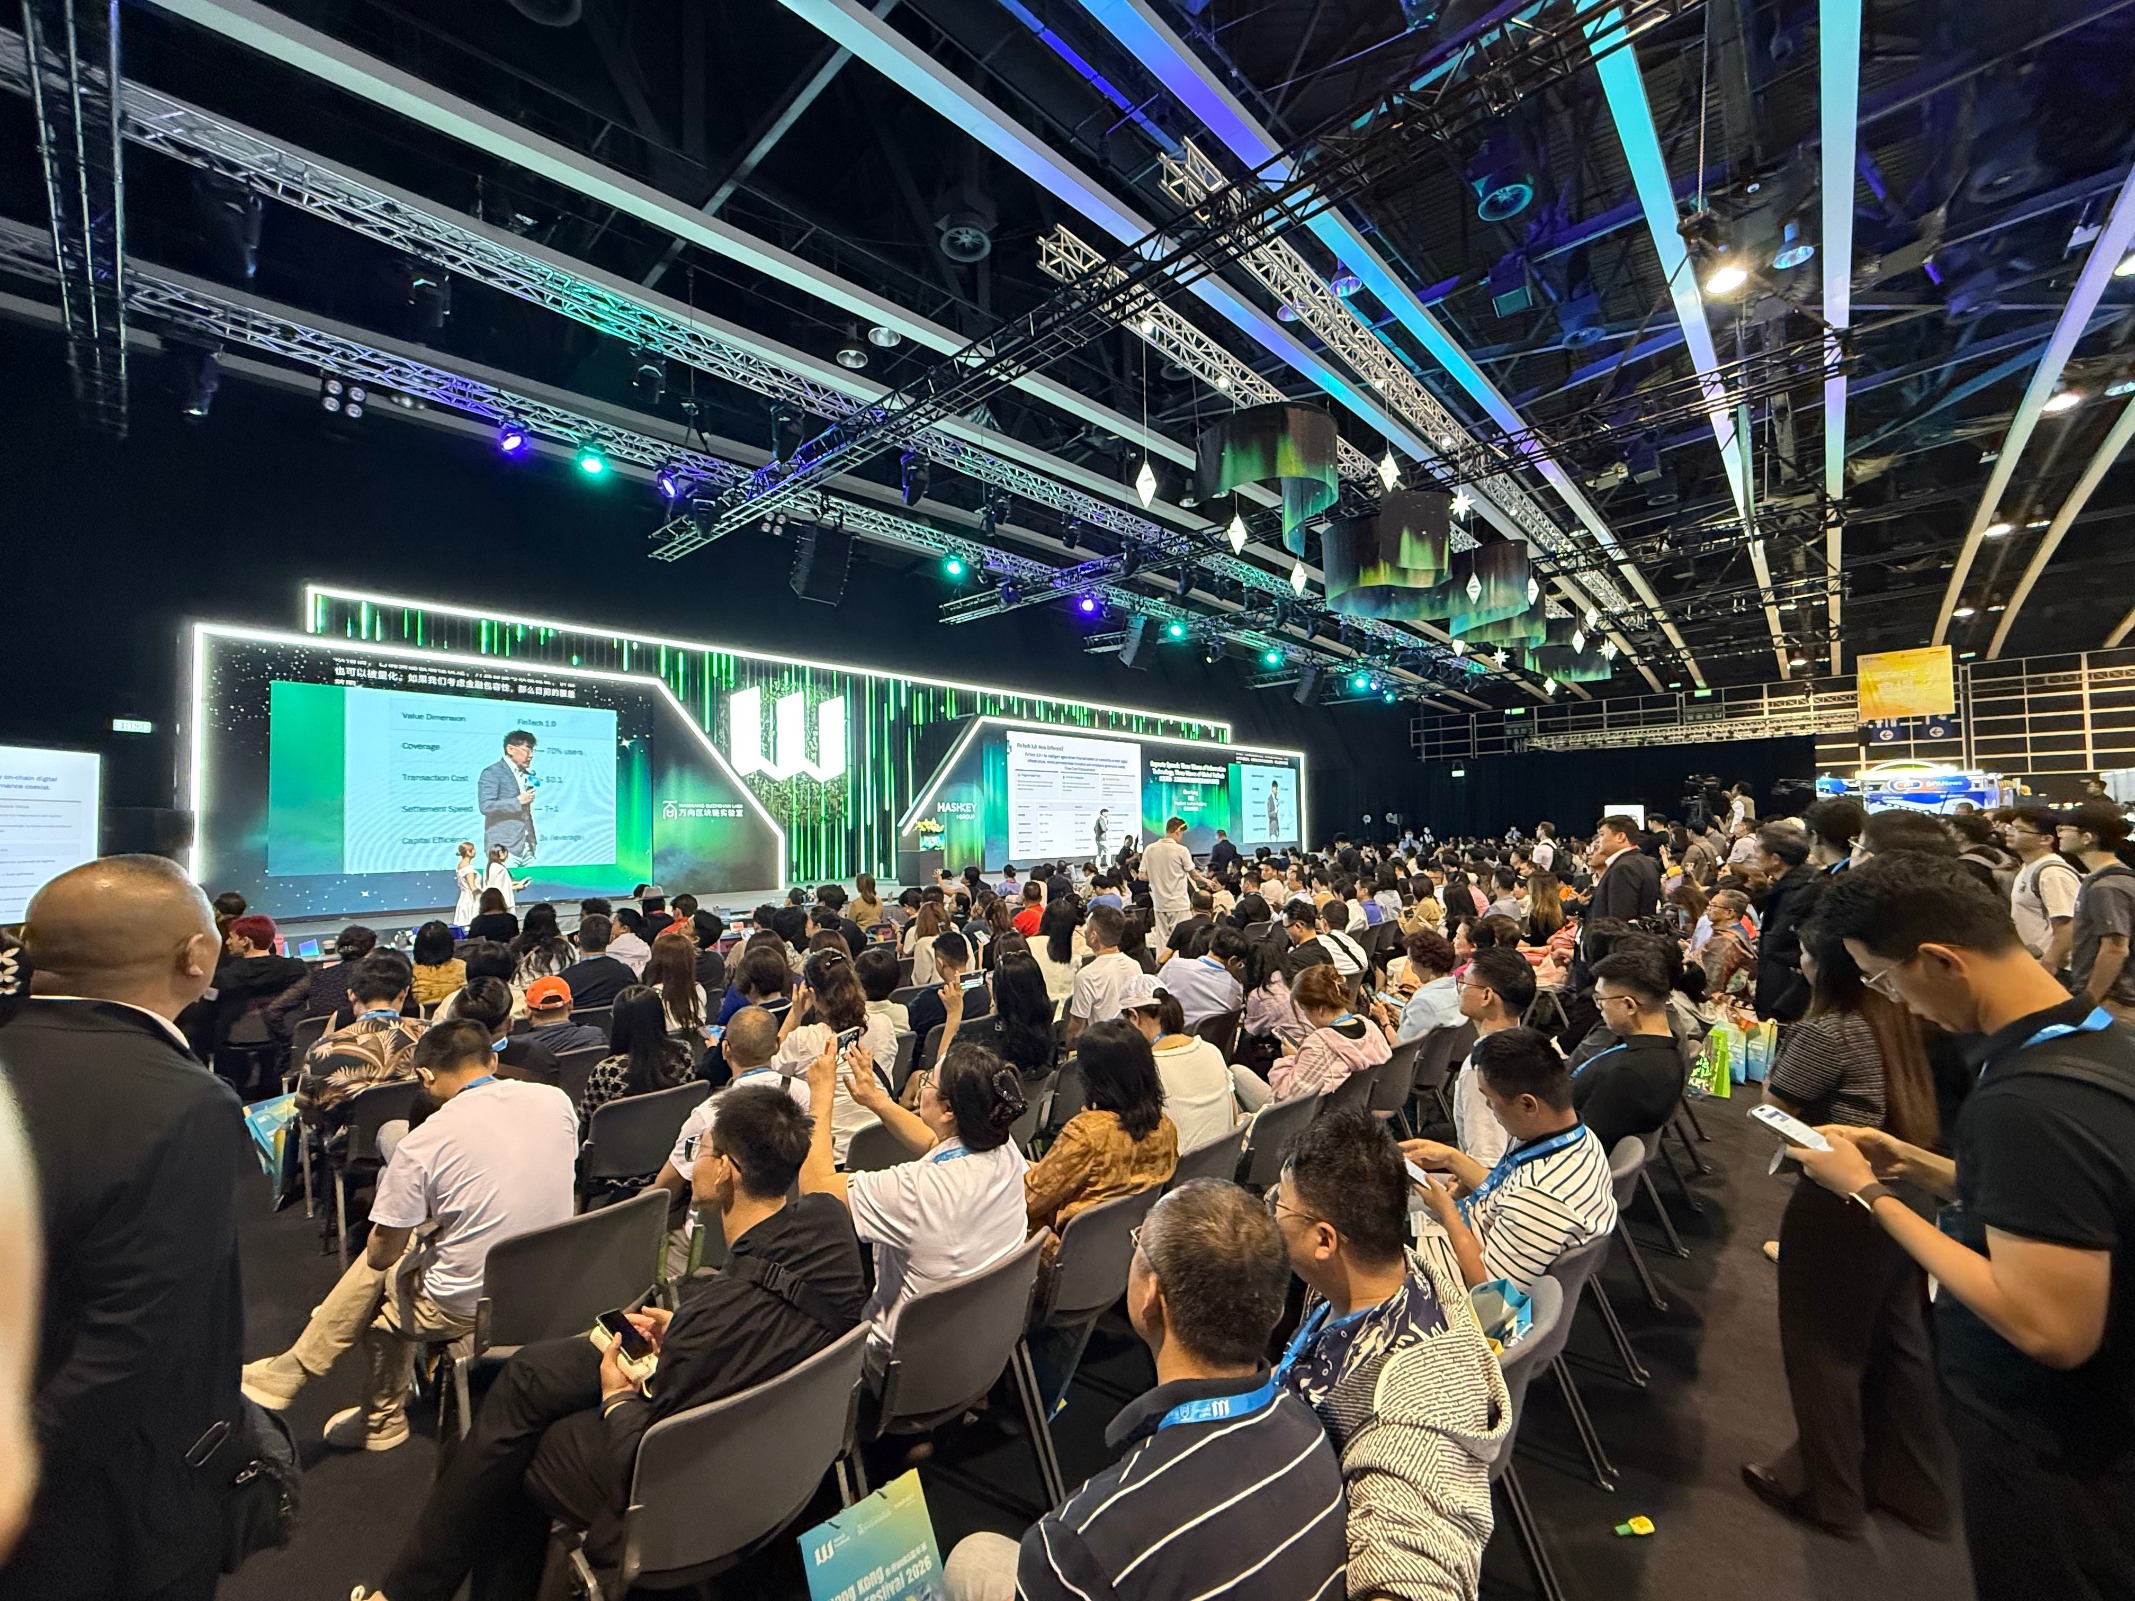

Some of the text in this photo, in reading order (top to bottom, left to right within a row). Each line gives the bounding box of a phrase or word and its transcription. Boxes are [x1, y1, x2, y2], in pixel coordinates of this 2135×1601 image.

[402, 742, 441, 752] Coverage
[402, 773, 469, 782] Transaction Cost
[448, 805, 474, 814] Speed
[937, 802, 977, 812] HASHKEY
[905, 1555, 933, 1585] 2026
[857, 1566, 885, 1595] Kong
